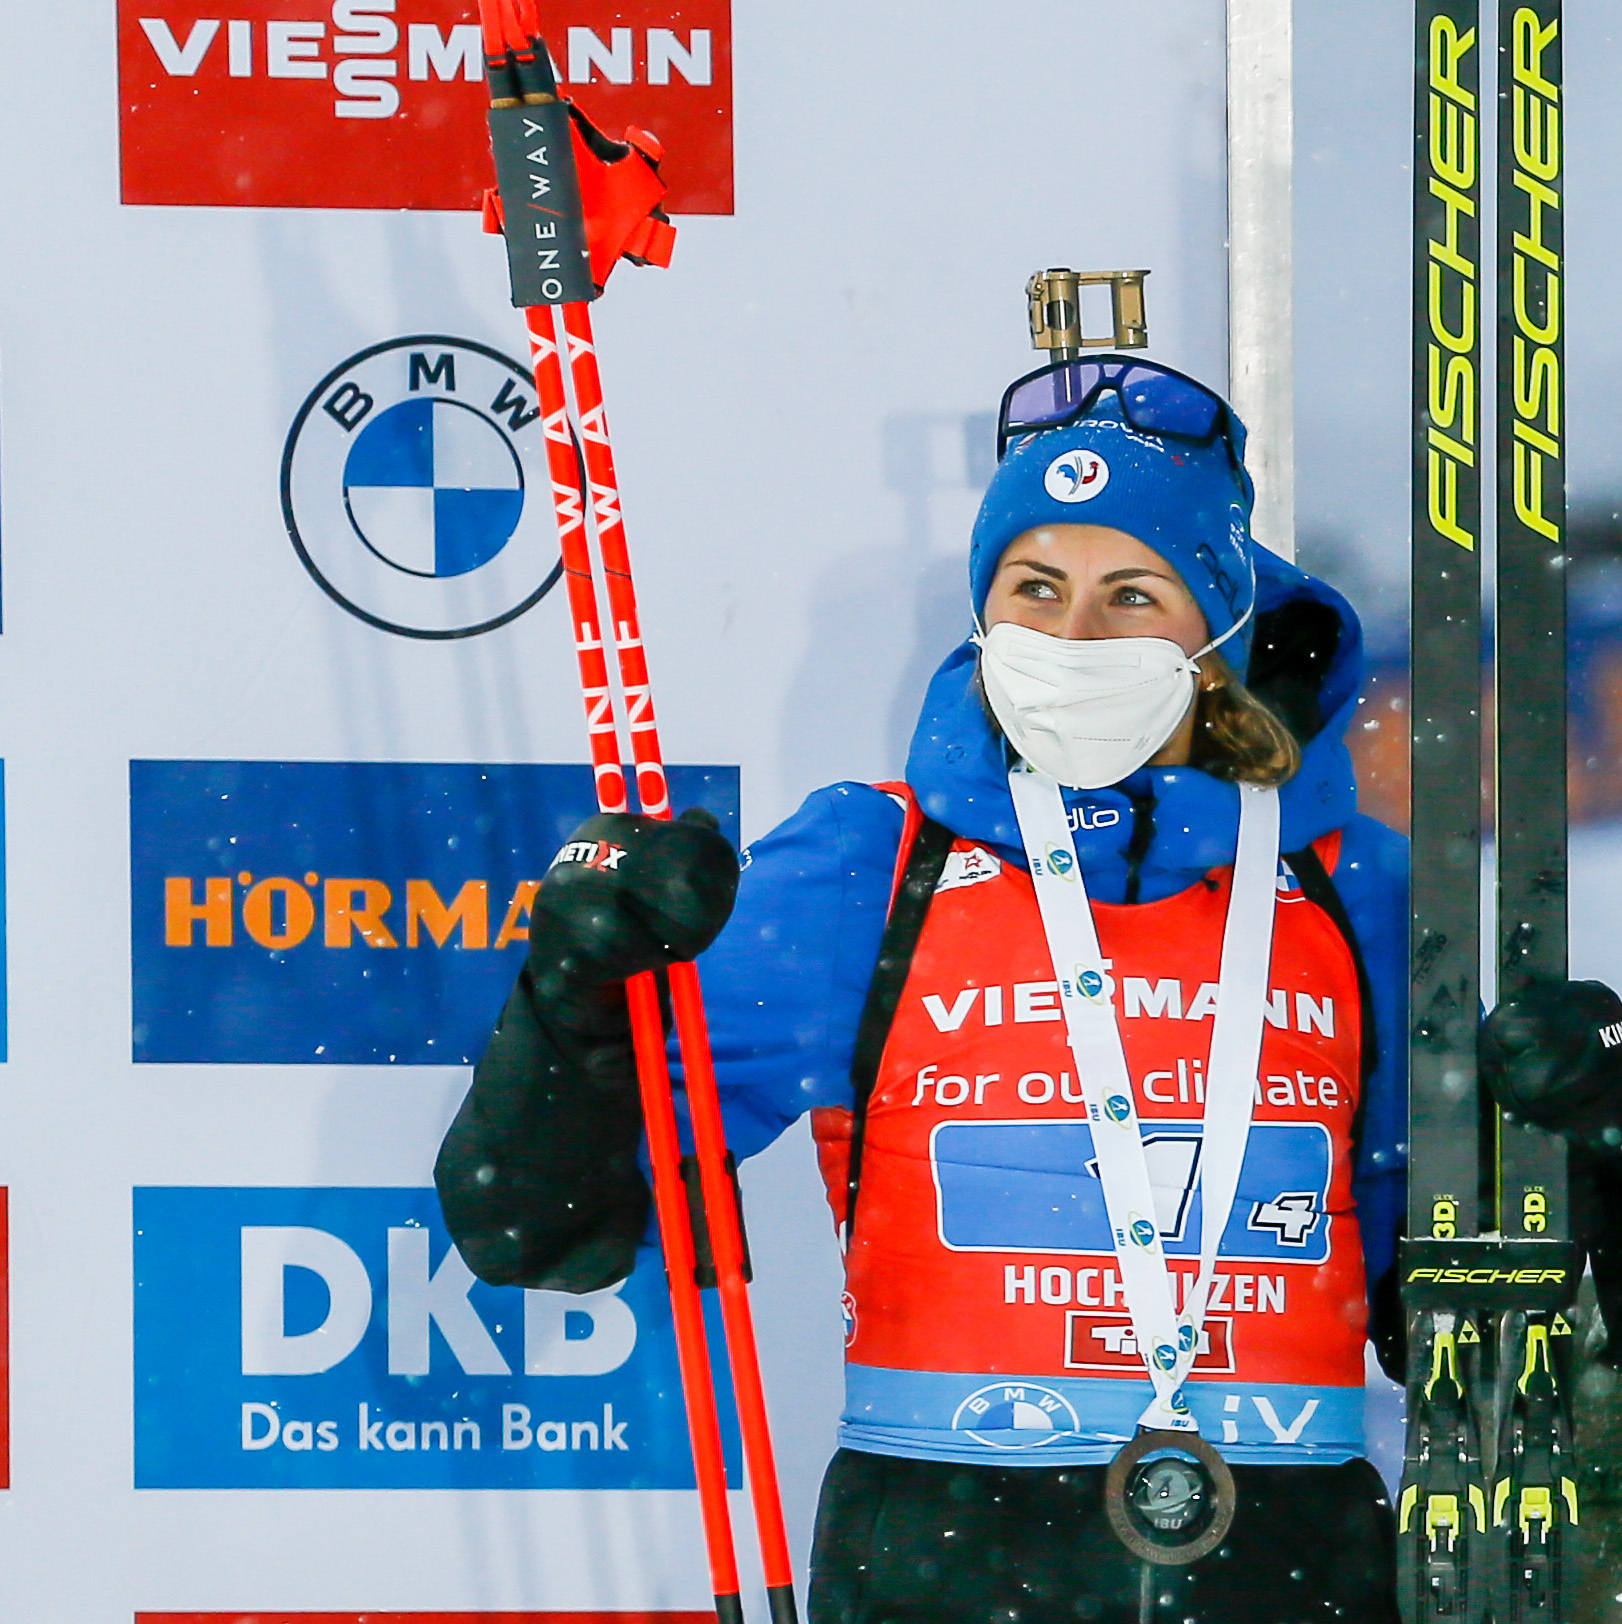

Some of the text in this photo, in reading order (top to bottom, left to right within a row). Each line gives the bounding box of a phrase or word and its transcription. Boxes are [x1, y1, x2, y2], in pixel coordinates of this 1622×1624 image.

[139, 0, 712, 119] VIESSMNN
[1427, 14, 1475, 550] FISCHER
[1512, 7, 1560, 543] FISCHER
[322, 353, 540, 434] BMW
[1066, 807, 1120, 832] dlo
[912, 1064, 1000, 1106] for
[1248, 1190, 1318, 1248] 4
[1523, 1192, 1546, 1232] 3D
[1407, 1268, 1566, 1283] FISCHER
[970, 1387, 1060, 1414] BMW
[242, 1405, 629, 1452] Das kann Bank
